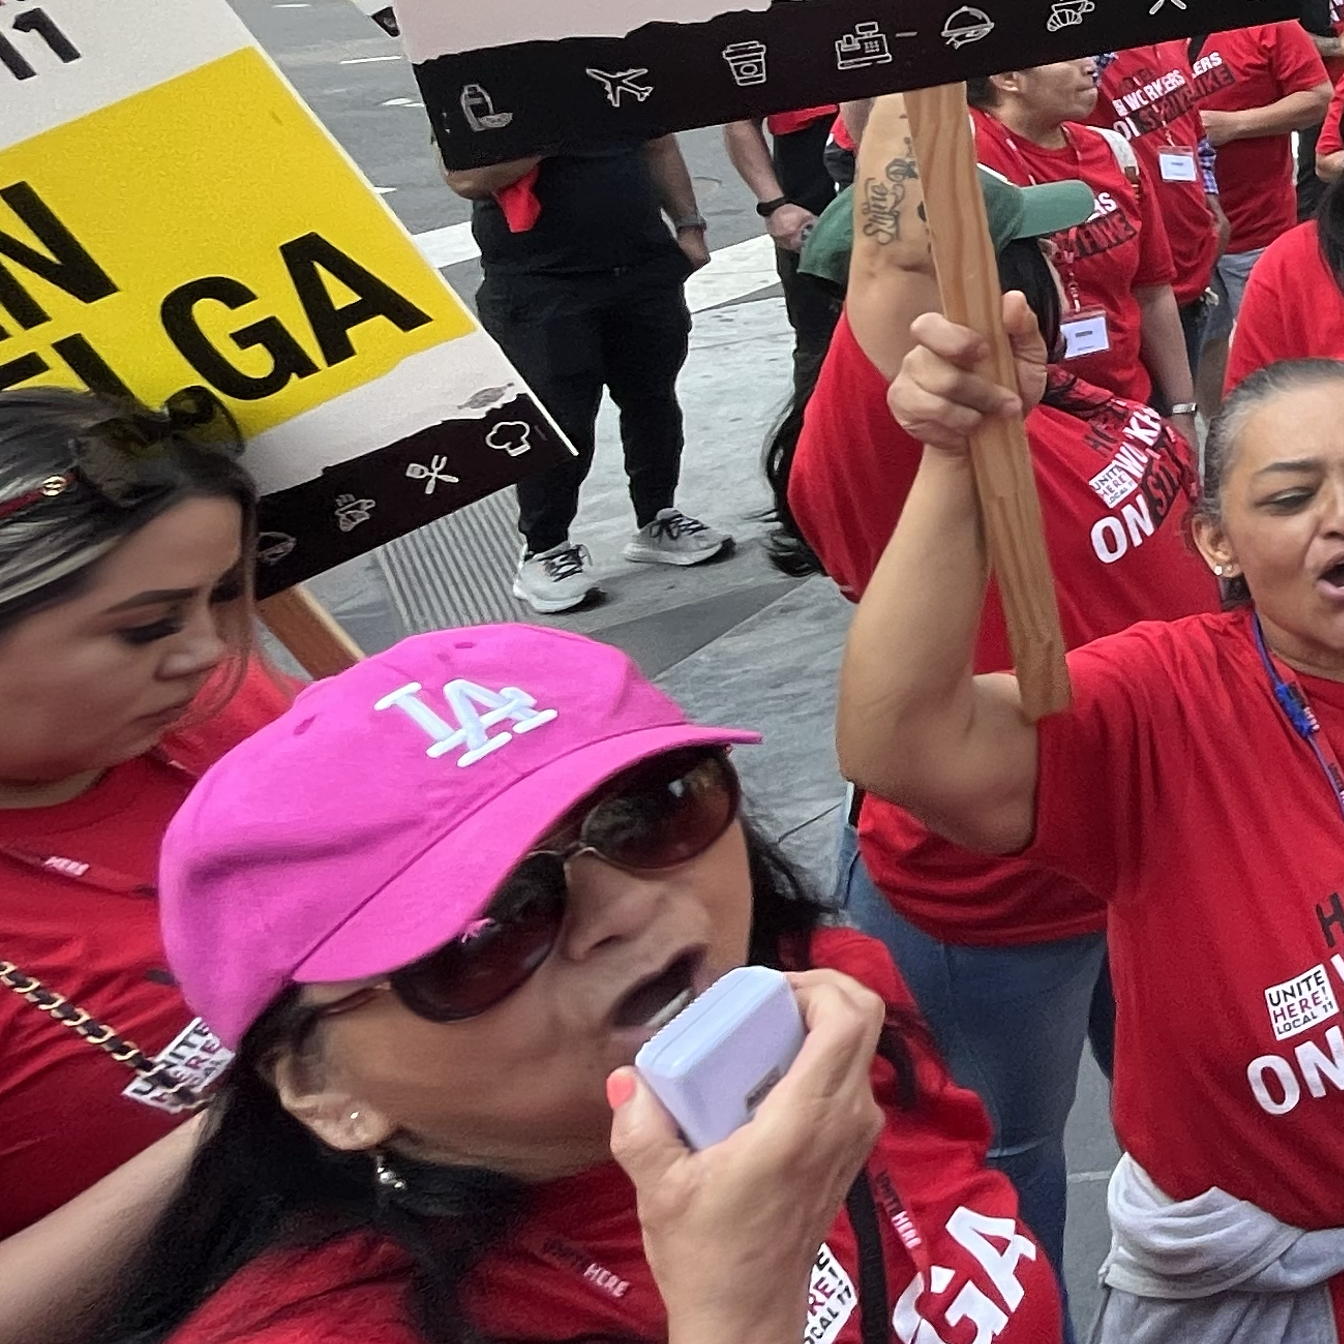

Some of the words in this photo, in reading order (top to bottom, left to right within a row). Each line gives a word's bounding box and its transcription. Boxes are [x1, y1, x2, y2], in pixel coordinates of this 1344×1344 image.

[1090, 494, 1155, 564] ON
[373, 678, 559, 768] LA
[1268, 969, 1325, 1007] UNITE
[1273, 986, 1329, 1024] HERE!
[1276, 1010, 1318, 1035] LOCAL
[1322, 1000, 1334, 1013] 11
[891, 1209, 923, 1250] HERE
[583, 1262, 631, 1298] HERE
[807, 1266, 846, 1318] RE!
